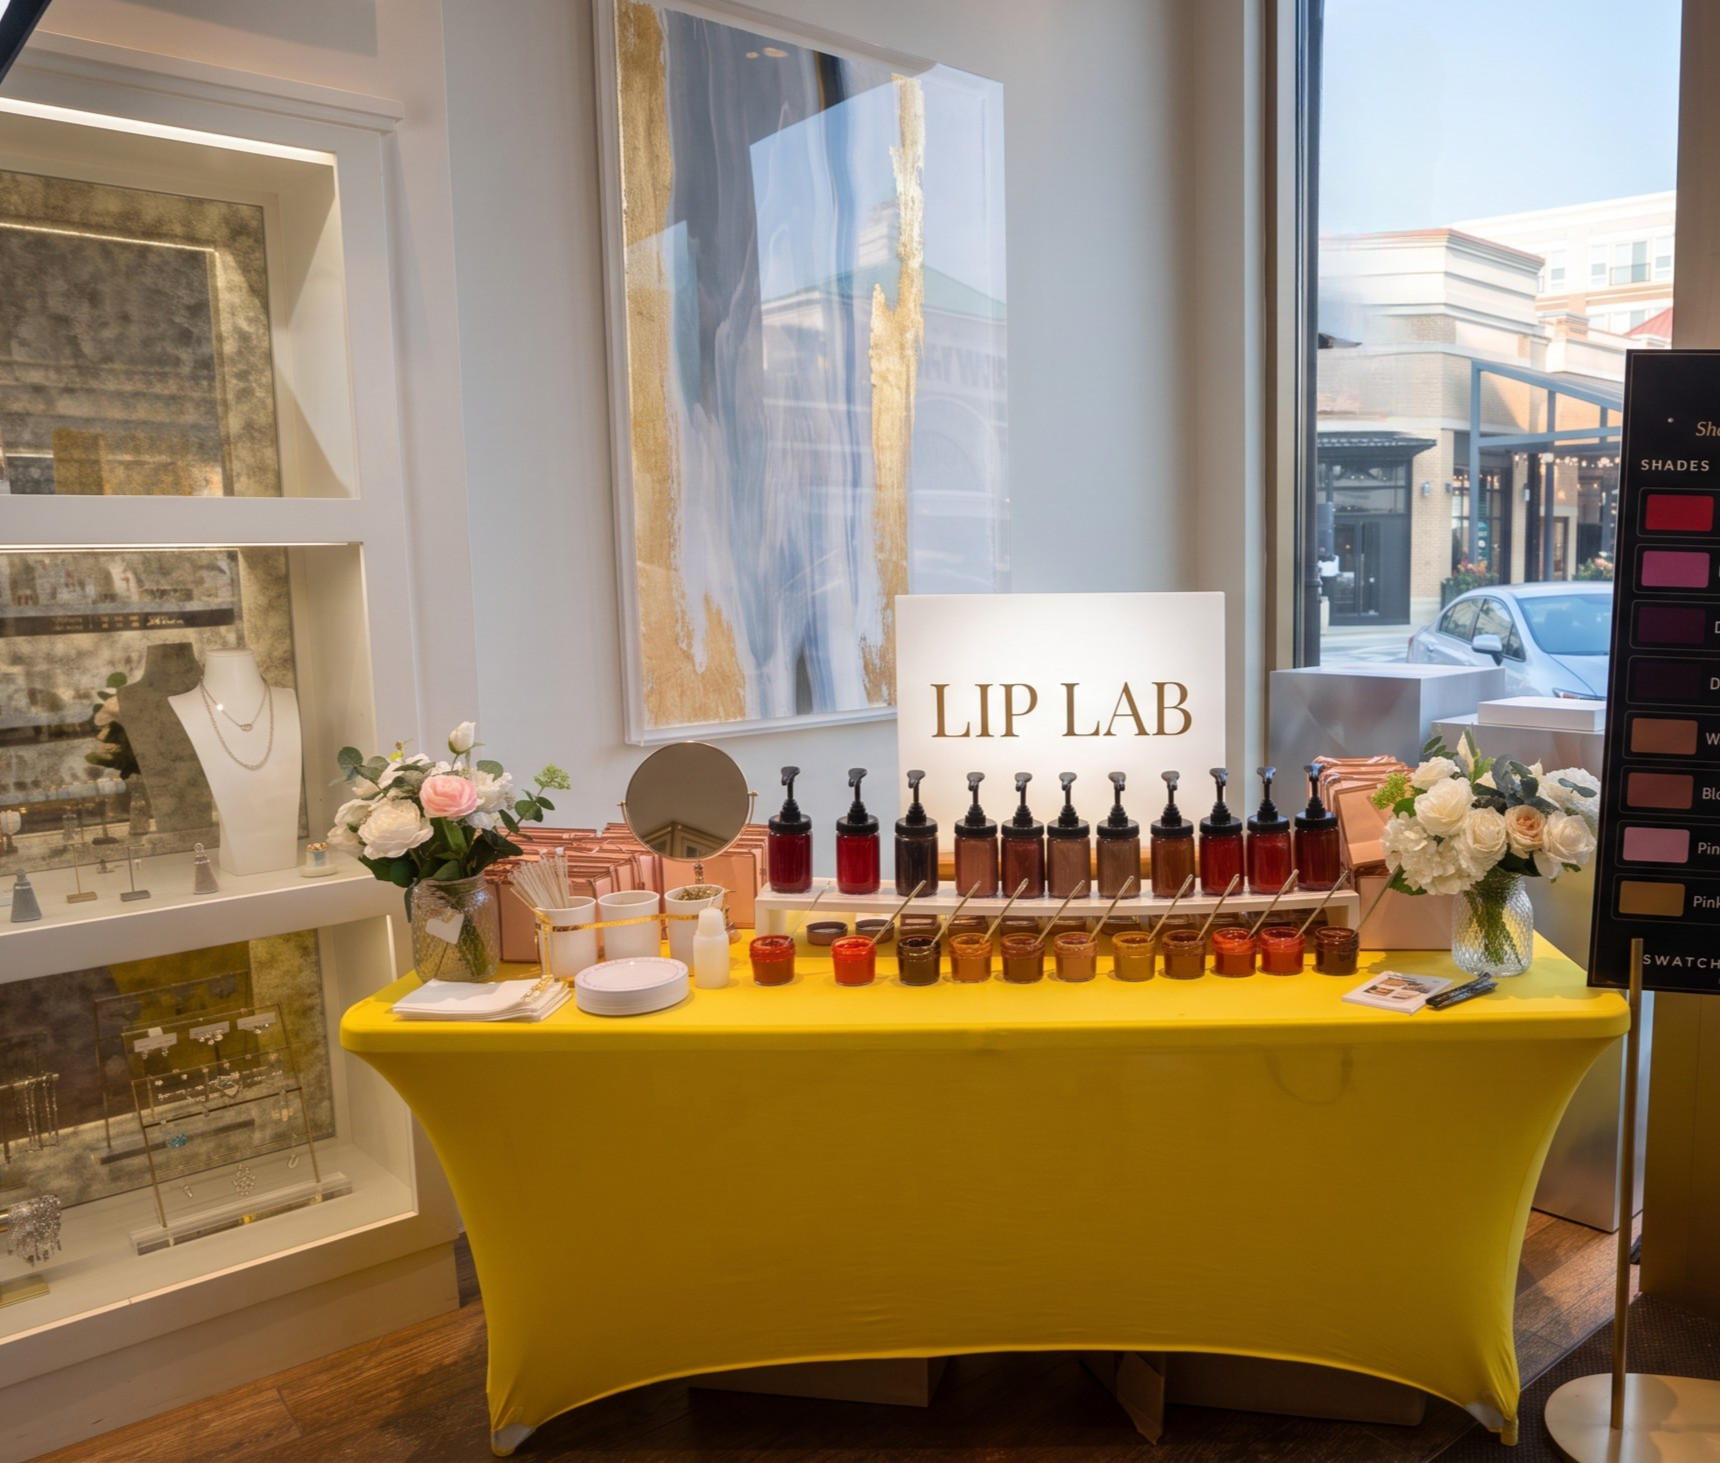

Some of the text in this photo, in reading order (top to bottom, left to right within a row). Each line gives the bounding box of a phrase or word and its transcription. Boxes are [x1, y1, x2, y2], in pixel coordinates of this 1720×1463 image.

[1641, 459, 1710, 472] SHADES
[931, 681, 1193, 738] LIP LAB
[1706, 732, 1720, 745] W
[1643, 954, 1720, 969] SWATCH
